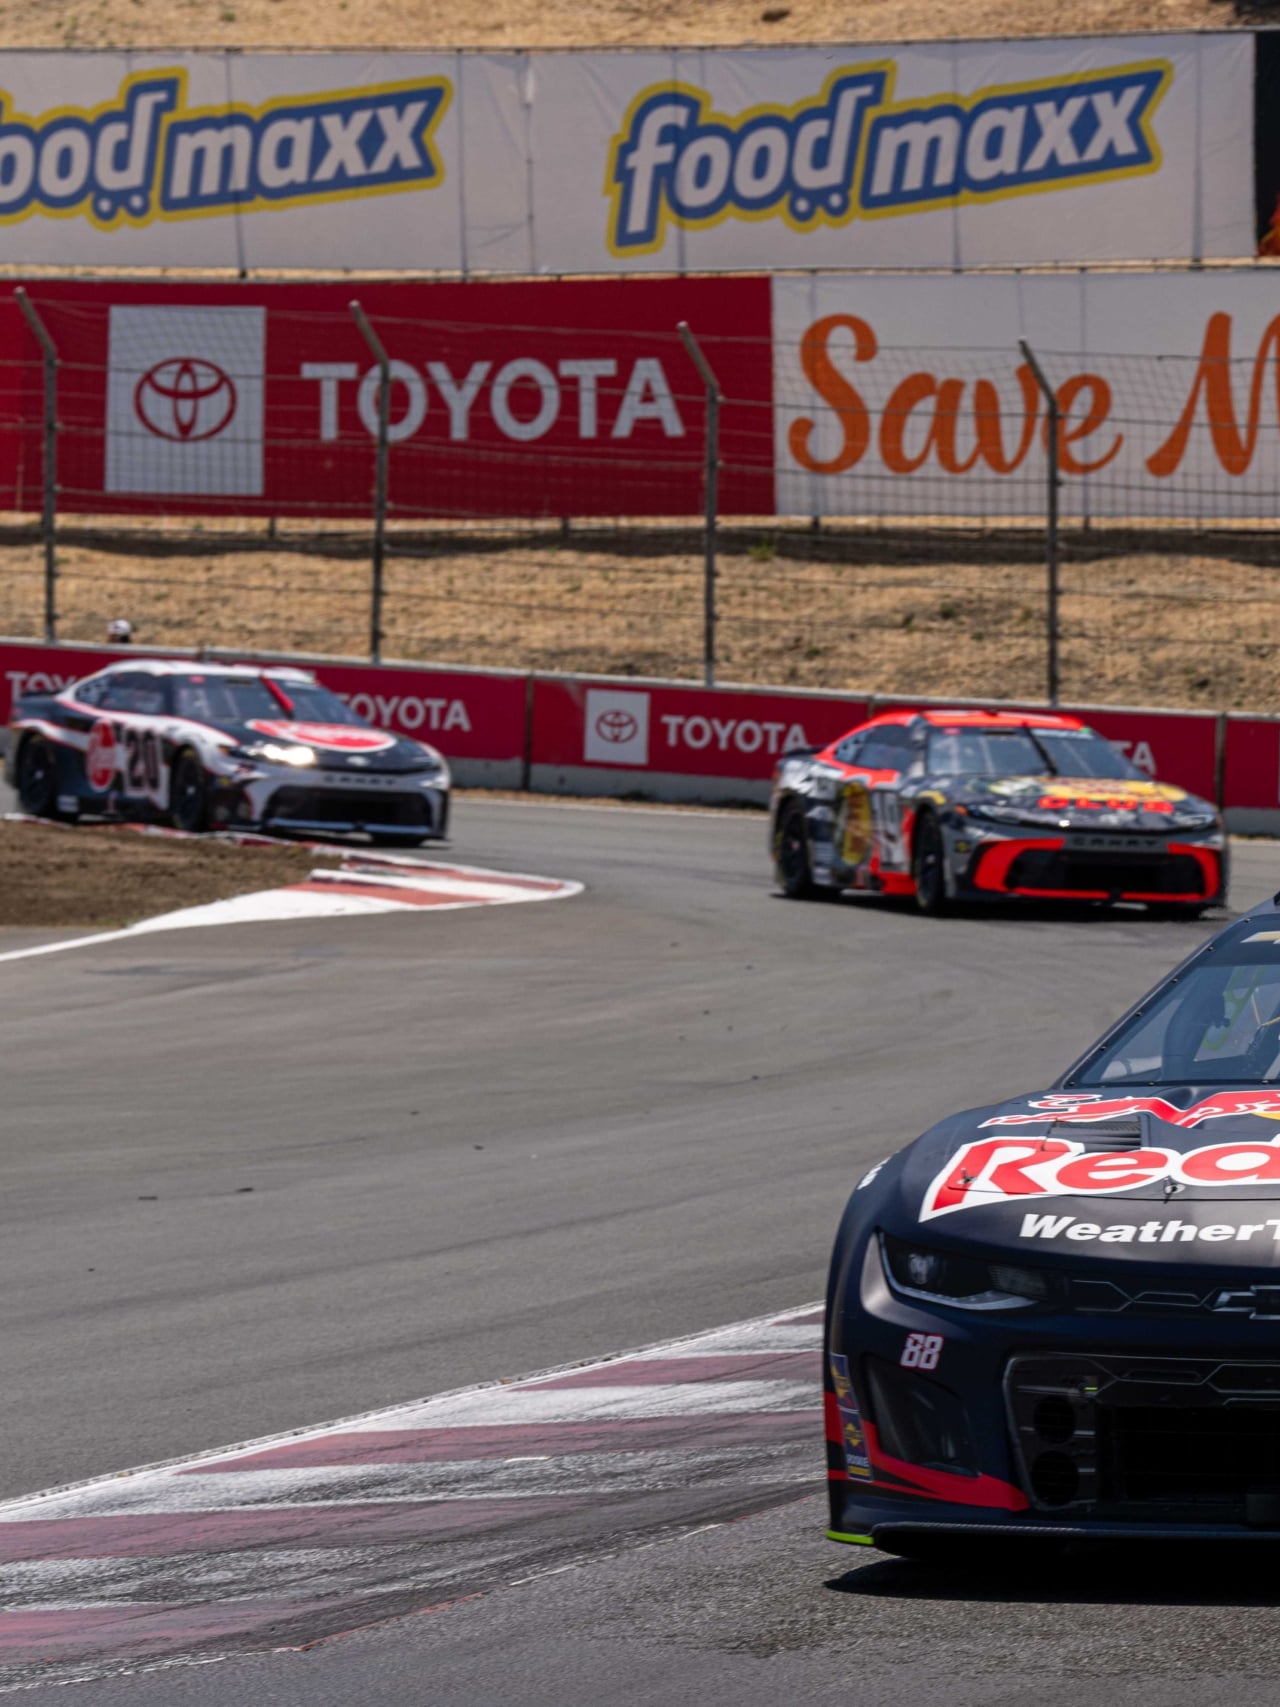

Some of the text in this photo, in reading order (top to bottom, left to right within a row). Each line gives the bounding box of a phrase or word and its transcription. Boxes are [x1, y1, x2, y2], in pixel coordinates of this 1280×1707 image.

[302, 358, 686, 442] TOYOTA
[788, 313, 1123, 474] Save
[5, 671, 78, 701] TOY
[660, 714, 810, 754] TOYOTA
[899, 1332, 943, 1371] 88
